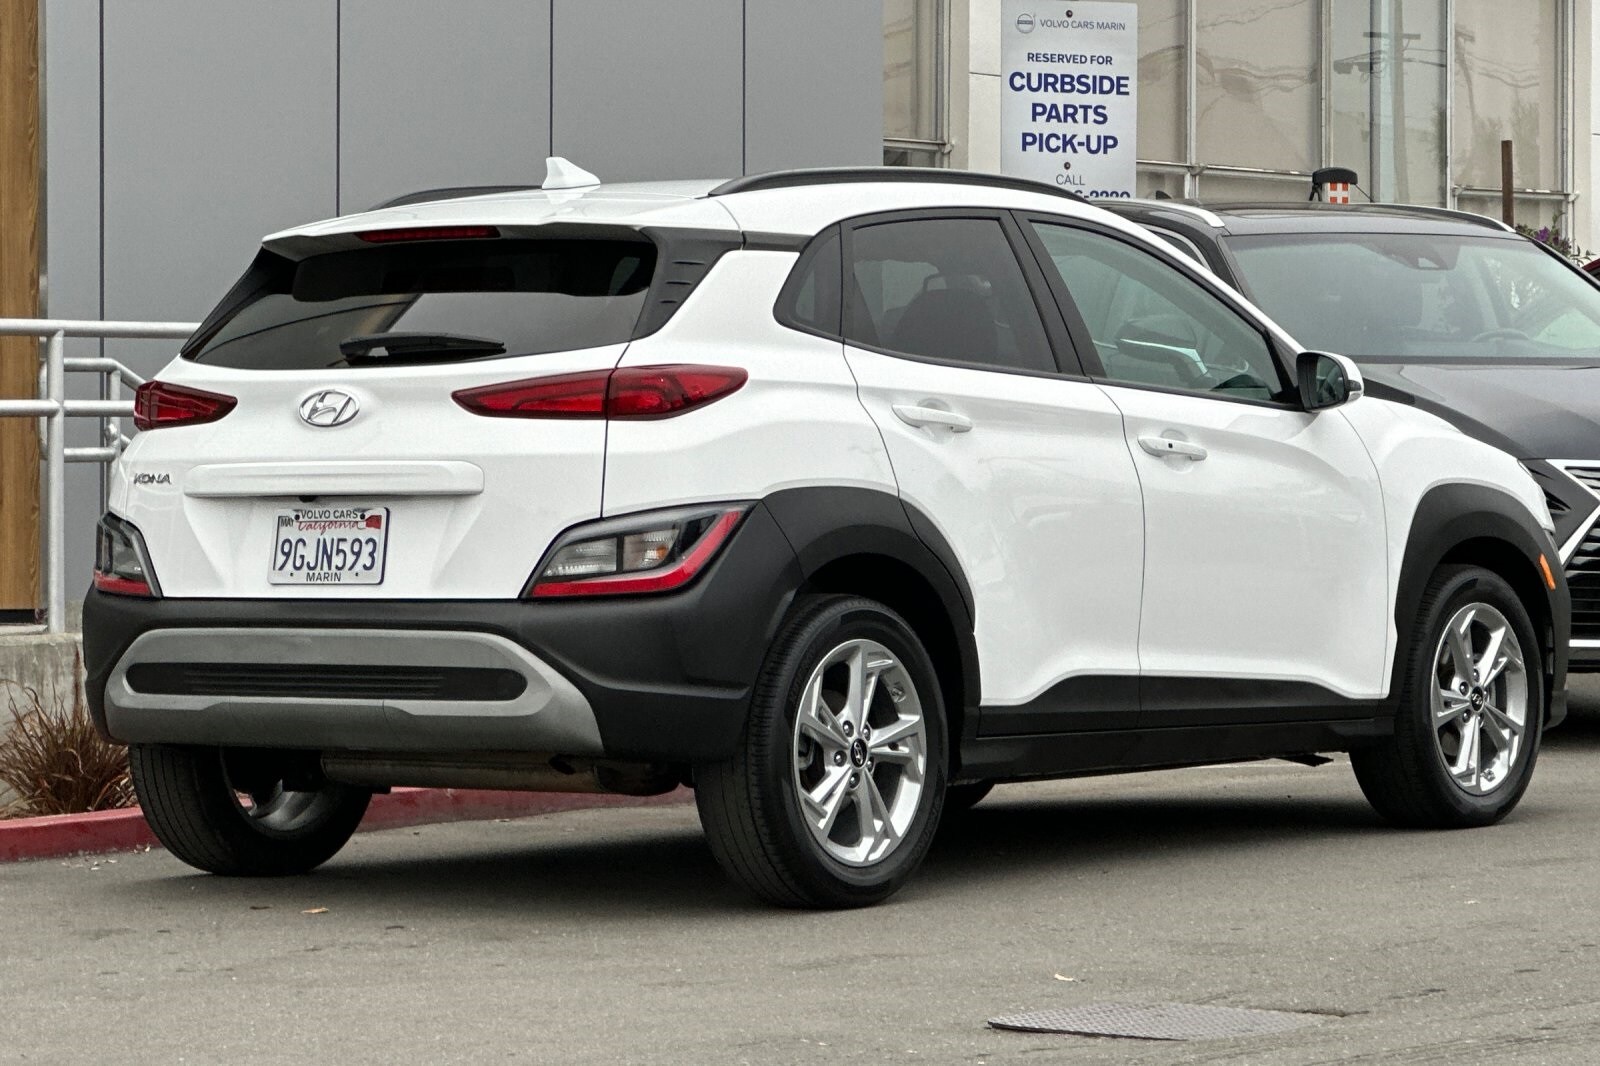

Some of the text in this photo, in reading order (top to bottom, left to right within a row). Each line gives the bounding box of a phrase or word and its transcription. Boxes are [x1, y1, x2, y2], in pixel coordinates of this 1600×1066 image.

[1040, 19, 1126, 31] VOLVO CARS MARIN
[1027, 52, 1113, 66] RESERVED FOR
[1009, 71, 1130, 96] CURBSIDE
[1031, 102, 1108, 125] PARTS
[1021, 132, 1119, 155] PICK-UP
[1055, 173, 1086, 186] CALL
[133, 473, 172, 485] KONA
[300, 509, 358, 519] VOLVO CARS
[297, 520, 366, 535] California
[278, 537, 378, 571] 9GJN593
[306, 572, 342, 582] MARIN
